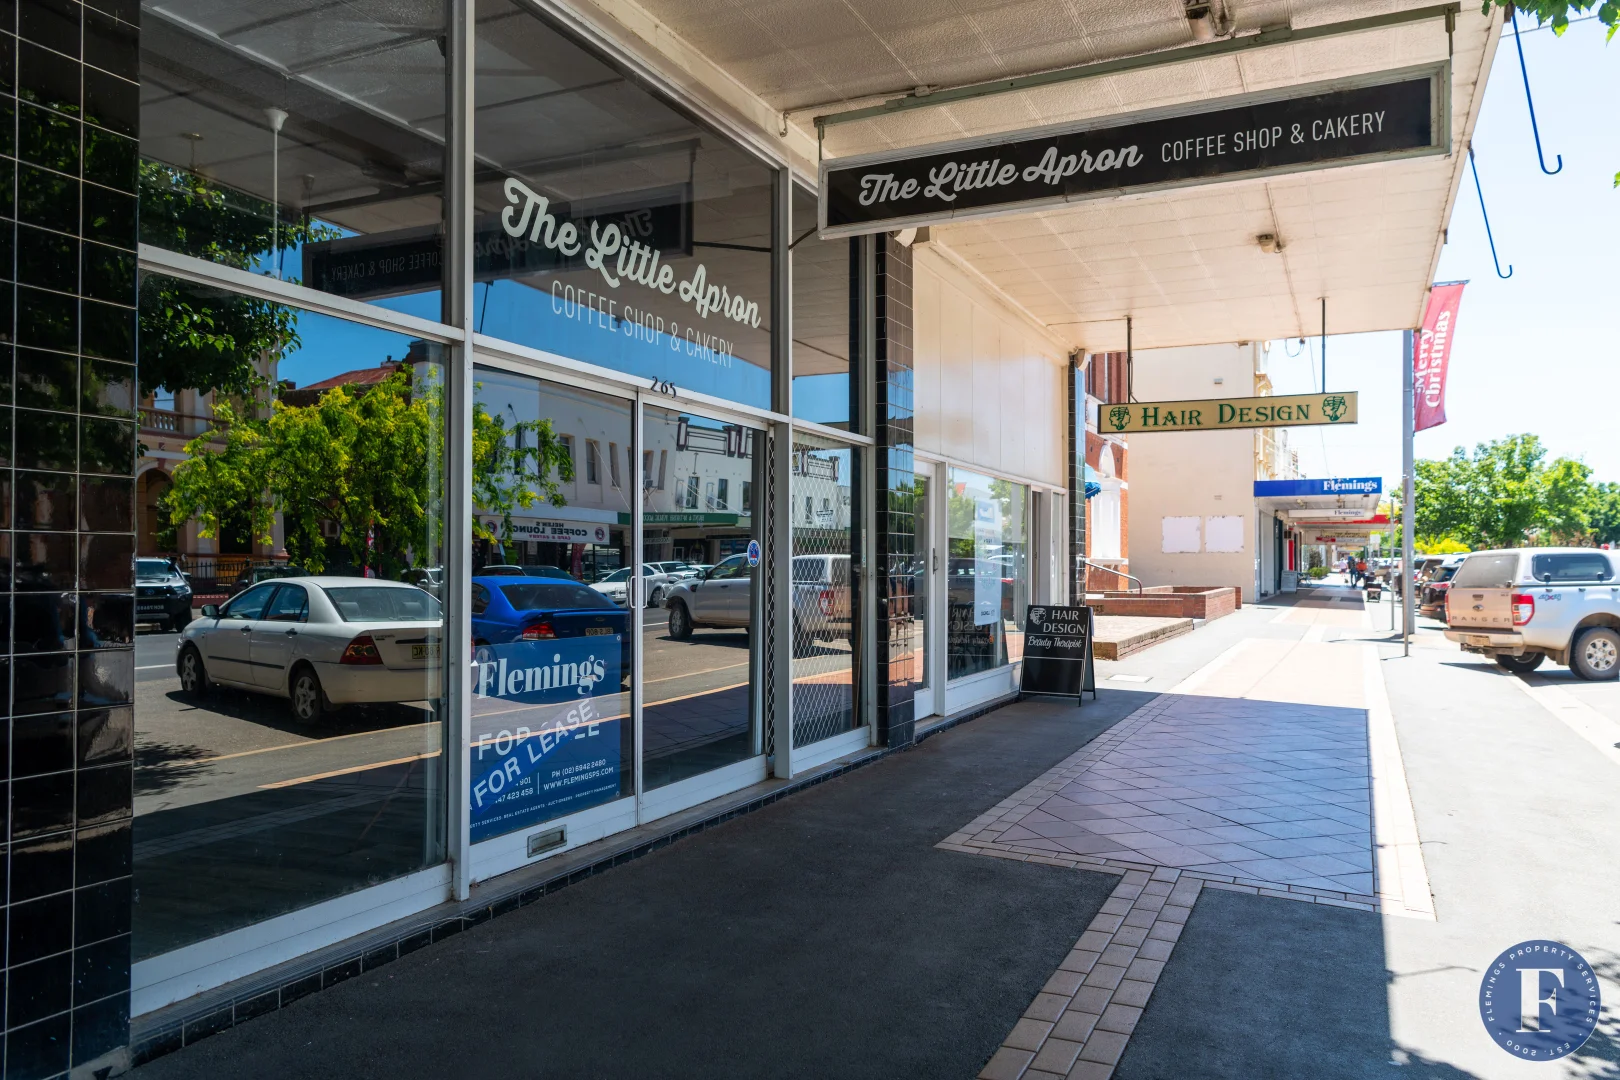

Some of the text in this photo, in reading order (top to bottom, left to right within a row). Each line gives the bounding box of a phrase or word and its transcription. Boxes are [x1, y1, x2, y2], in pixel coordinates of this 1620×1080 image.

[859, 111, 1386, 206] The Little Apron COFFEE SHOP & CAKERY
[501, 177, 761, 328] The Little Apron
[551, 280, 734, 368] COFFEE SHOP & CAKERY
[1415, 328, 1434, 394] Merry
[1425, 310, 1450, 408] Christmas
[651, 375, 676, 399] 265
[1323, 479, 1378, 493] Flemings
[1043, 622, 1086, 634] DESIGN
[1051, 610, 1079, 621] HAIR
[1028, 636, 1082, 650] Beauty Therapist
[477, 653, 606, 700] Flemings
[473, 756, 521, 808] FOR
[527, 698, 594, 764] LEASE
[543, 766, 614, 791] WWW.FLEMINGSPS.COM
[551, 769, 561, 778] PH
[561, 766, 575, 777] (02)
[506, 791, 520, 801] 423
